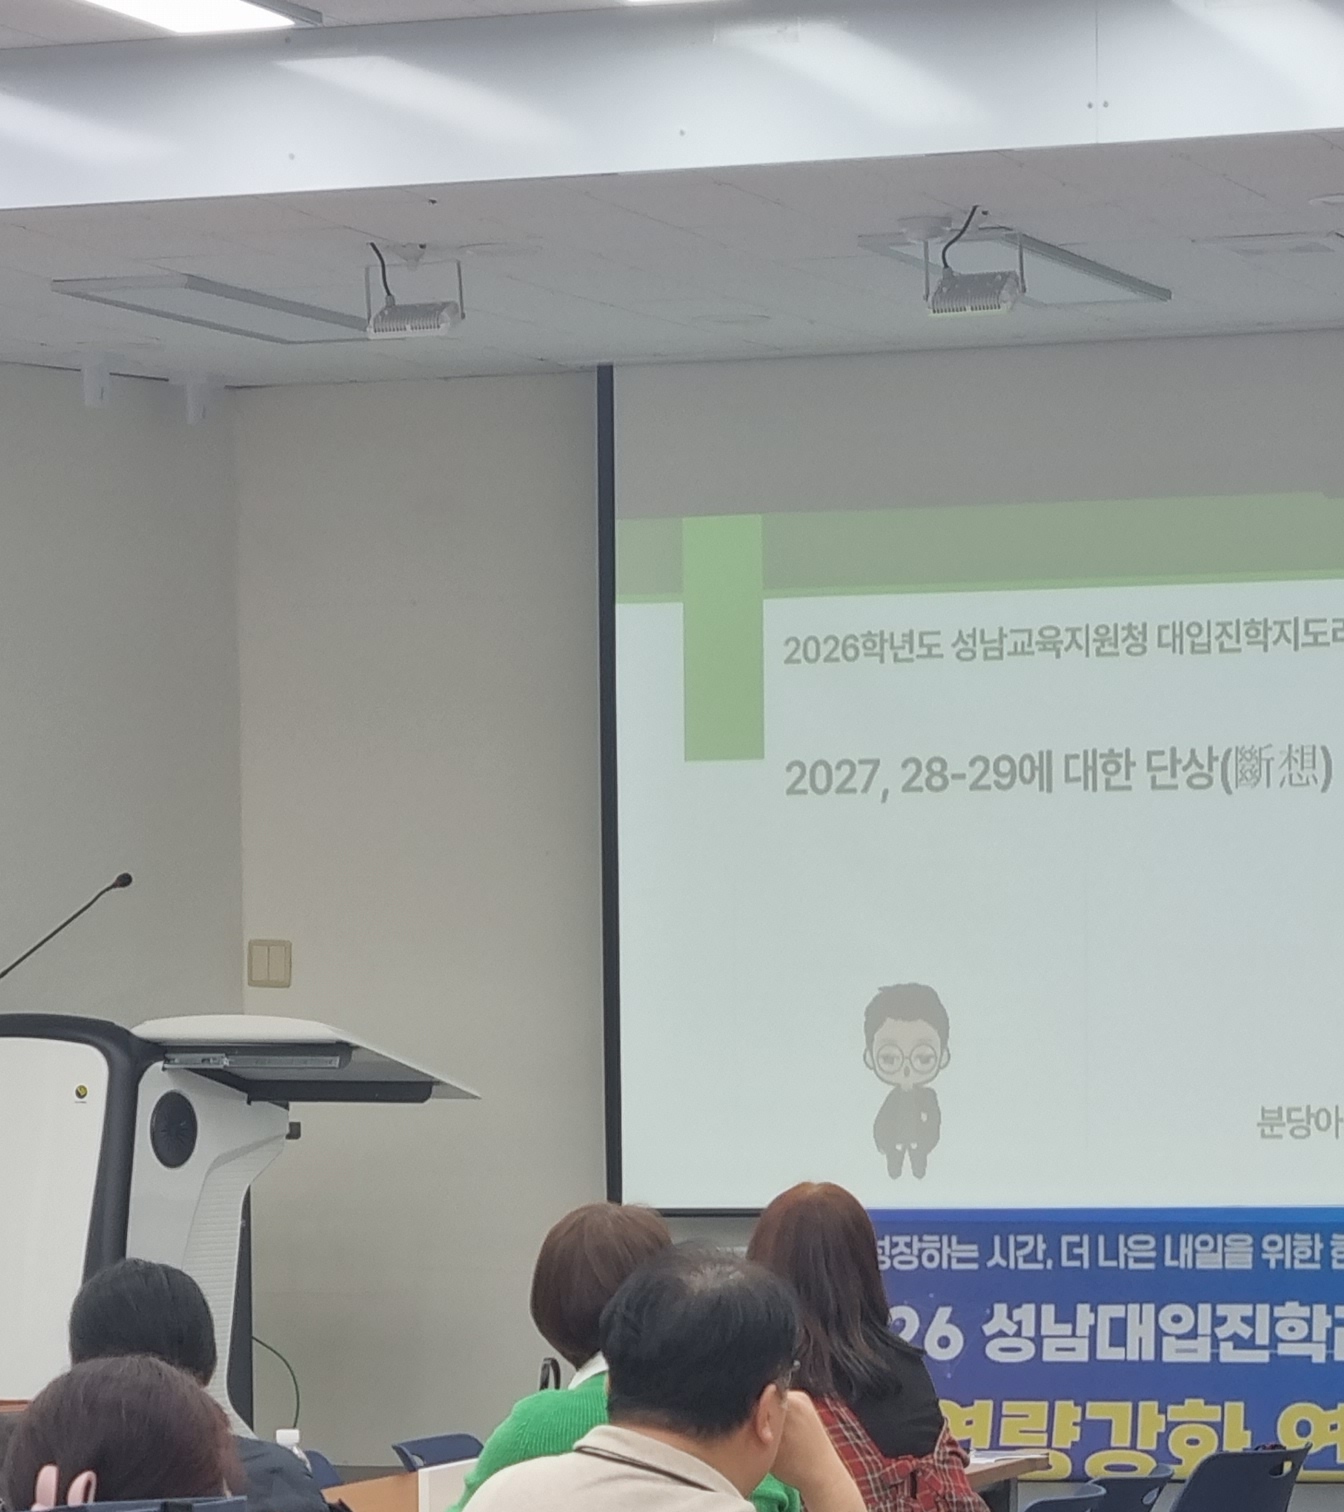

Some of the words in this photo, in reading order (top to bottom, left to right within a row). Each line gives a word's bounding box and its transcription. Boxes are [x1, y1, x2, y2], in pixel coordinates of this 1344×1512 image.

[783, 630, 945, 664] 2026학년도
[950, 621, 1148, 662] 성남교육지원청
[785, 757, 889, 804] 2027,
[900, 749, 1054, 794] 28-29에
[1064, 746, 1137, 792] 대한
[986, 1233, 1053, 1271] 시간,
[1060, 1233, 1090, 1271] 더
[1098, 1233, 1157, 1271] 나은
[1164, 1233, 1254, 1271] 내일을
[1261, 1233, 1324, 1271] 위한
